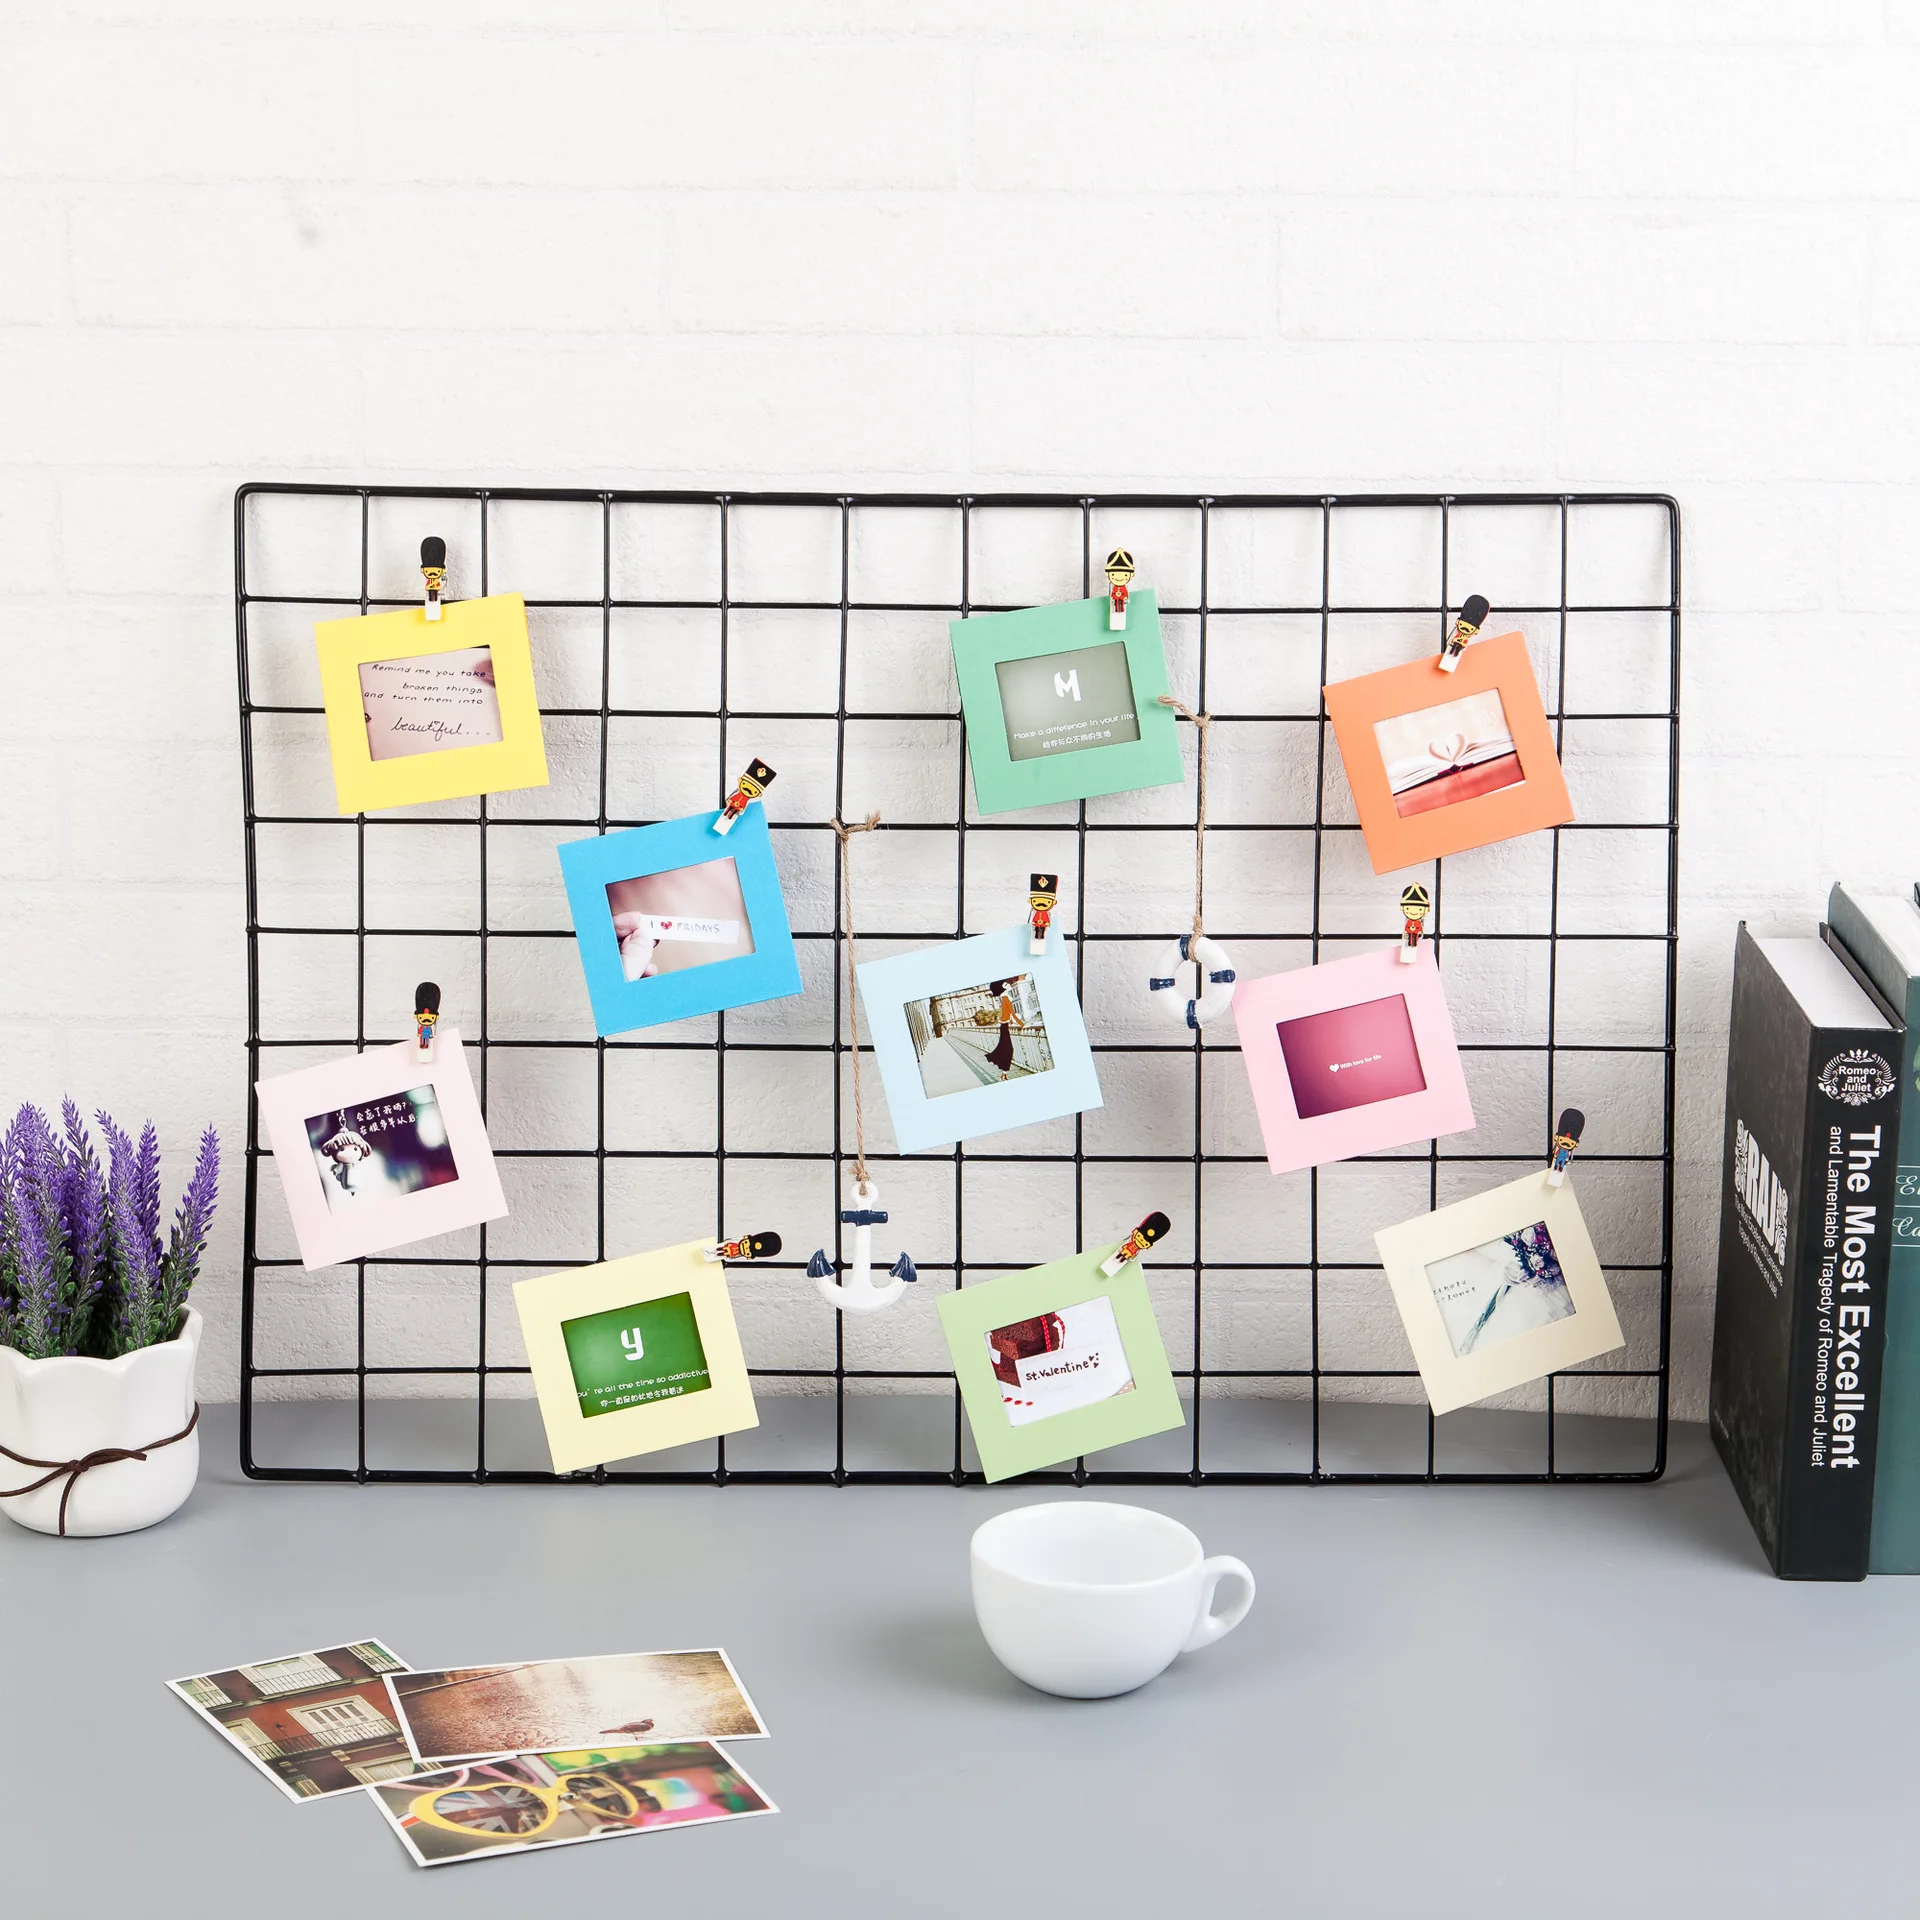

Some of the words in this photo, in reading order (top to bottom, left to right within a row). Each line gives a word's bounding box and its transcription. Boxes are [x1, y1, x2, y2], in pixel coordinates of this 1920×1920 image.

[372, 664, 411, 673] Remind
[437, 670, 455, 678] you
[461, 670, 486, 678] take
[364, 691, 384, 699] and
[402, 682, 439, 691] broken
[446, 685, 483, 695] things
[1053, 669, 1082, 702] M
[1013, 730, 1036, 740] Make
[1045, 720, 1088, 735] difference
[1089, 718, 1099, 727] in
[1100, 714, 1119, 725] your
[676, 922, 720, 933] FRIDAYS
[1839, 1066, 1877, 1075] Romeo
[1847, 1075, 1867, 1083] and
[1841, 1083, 1872, 1092] Juliet
[1829, 1126, 1844, 1155] and
[1846, 1124, 1882, 1193] The
[1823, 1160, 1843, 1248] Lamentable
[1841, 1205, 1877, 1293] Most
[1817, 1252, 1838, 1316] Tragedy
[1818, 1318, 1833, 1334] of
[1814, 1337, 1833, 1391] Romeo
[604, 1385, 616, 1393] all
[618, 1382, 634, 1390] the
[636, 1378, 655, 1387] time
[1830, 1305, 1871, 1469] Excellent
[1814, 1396, 1828, 1423] and
[1811, 1428, 1827, 1467] Juliet
